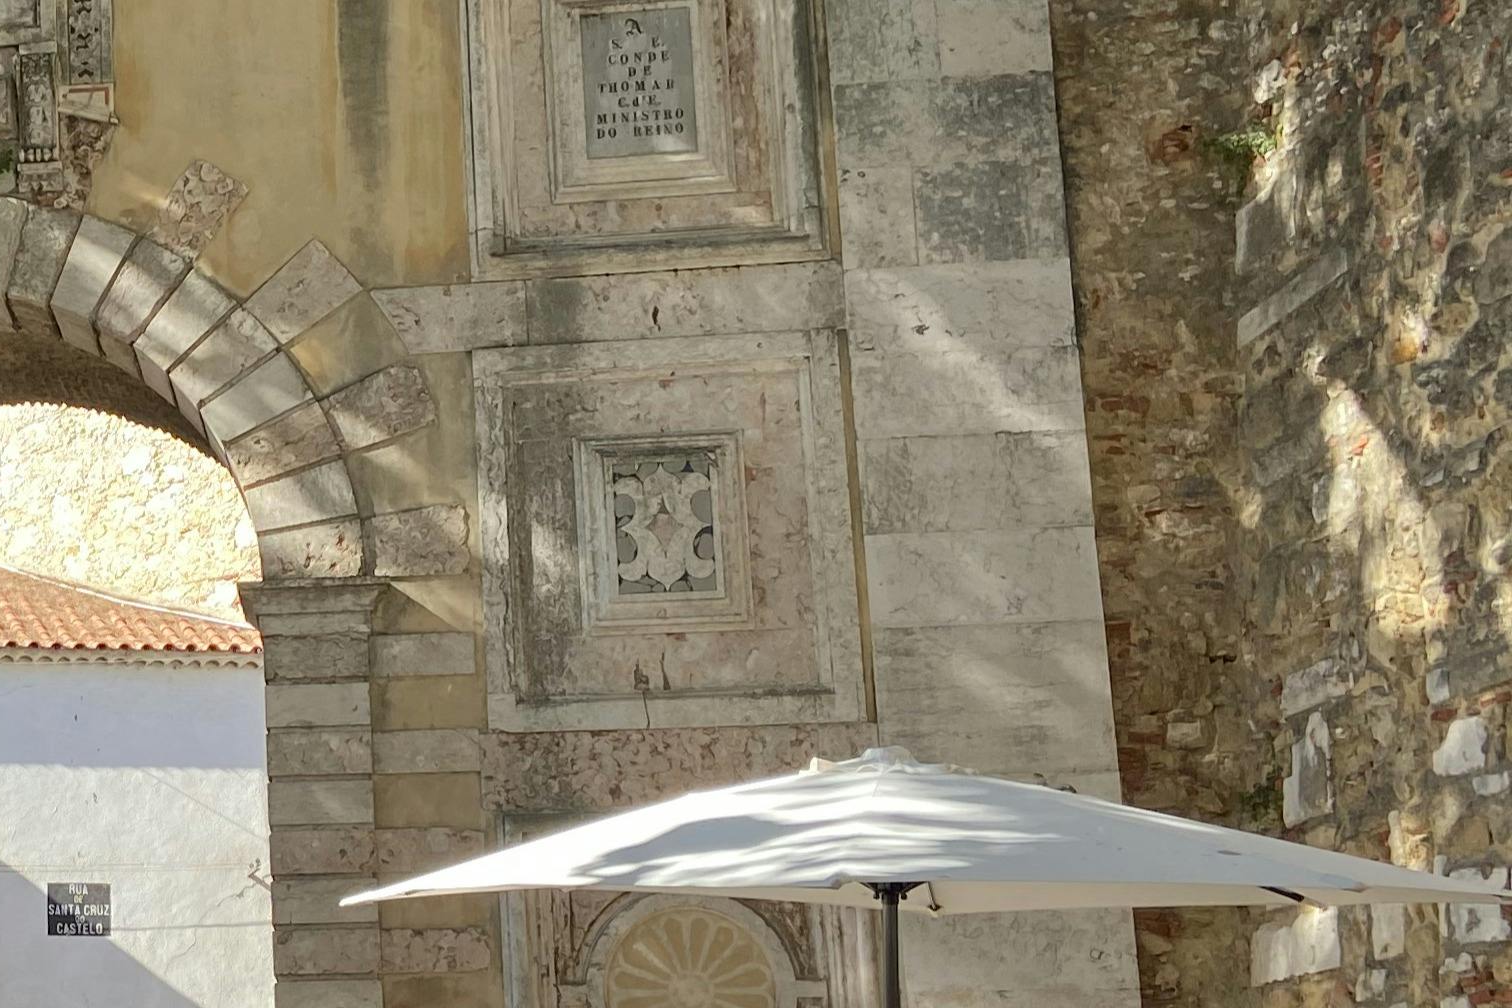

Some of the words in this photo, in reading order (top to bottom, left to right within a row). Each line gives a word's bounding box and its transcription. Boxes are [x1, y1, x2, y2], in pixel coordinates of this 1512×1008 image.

[608, 50, 670, 65] CONDE
[628, 65, 652, 77] DE
[598, 79, 675, 94] THOMAR
[596, 108, 684, 125] MINISTRO
[596, 128, 617, 139] DO
[633, 122, 684, 137] REINO
[68, 883, 89, 895] RUA
[48, 904, 81, 916] SANTA
[83, 904, 110, 916] CRUZ
[56, 923, 103, 935] CASTELO
